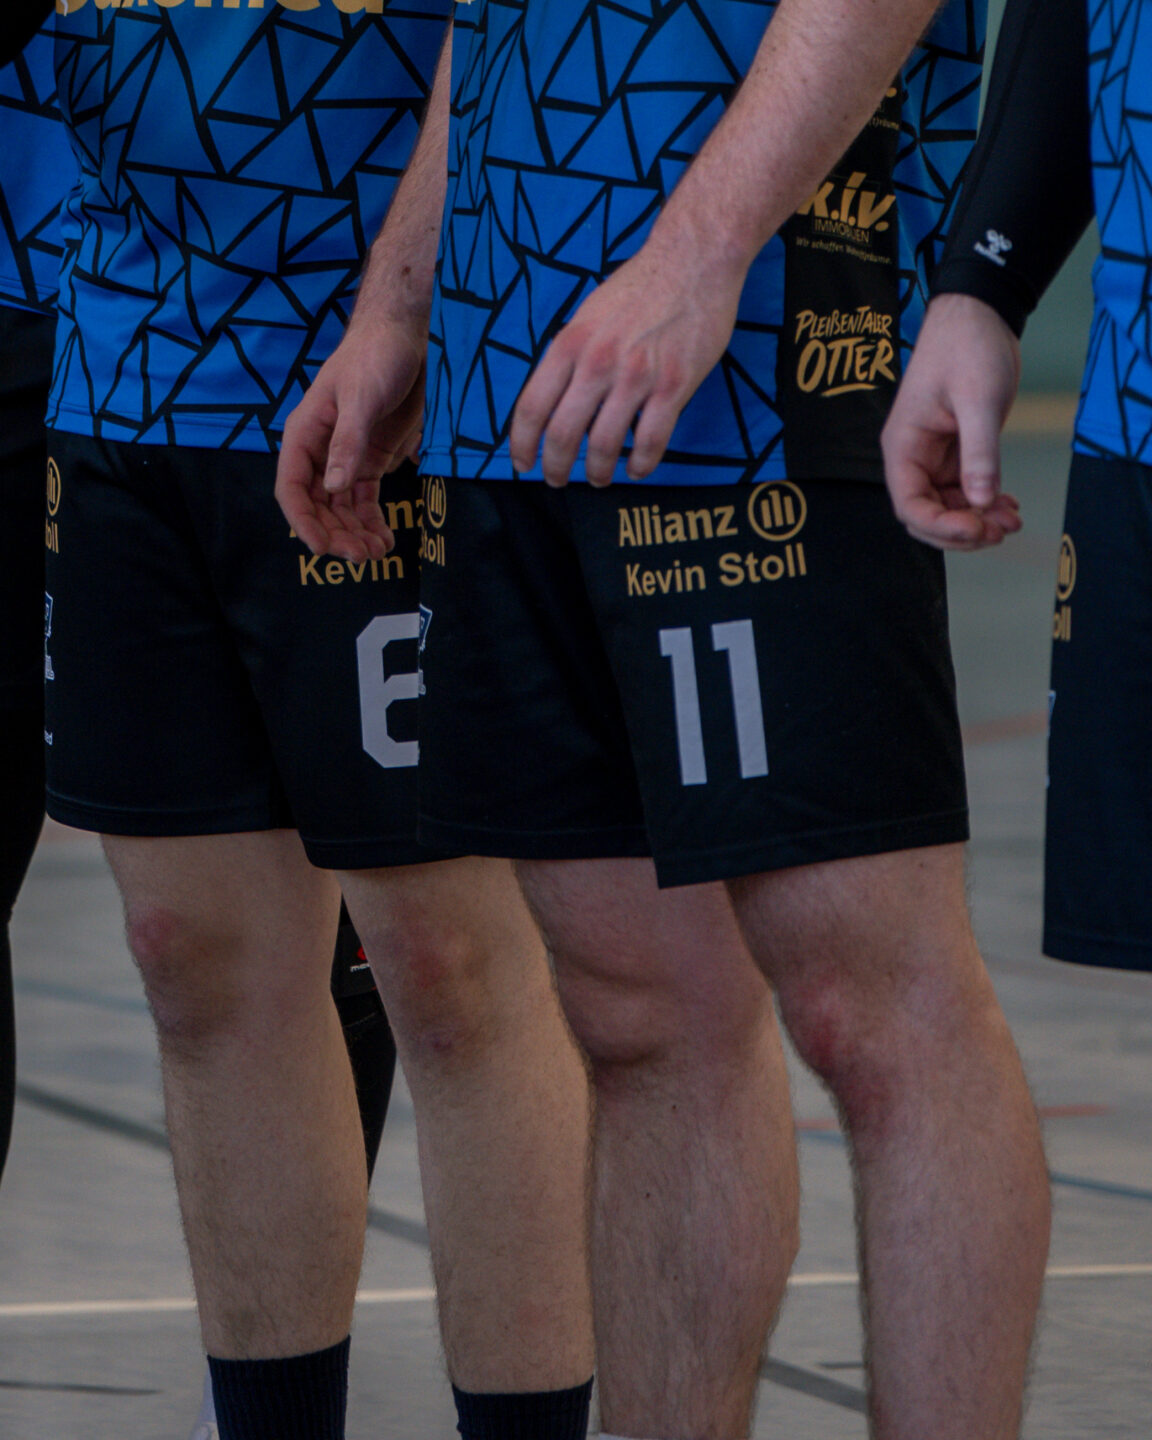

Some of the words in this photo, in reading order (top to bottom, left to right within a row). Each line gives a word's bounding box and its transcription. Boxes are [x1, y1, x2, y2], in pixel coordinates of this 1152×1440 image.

[797, 336, 897, 394] OTTER
[618, 503, 739, 548] Allianz
[298, 554, 405, 586] Kevin
[625, 560, 707, 597] Kevin
[718, 542, 808, 588] Stoll
[659, 618, 770, 787] 11
